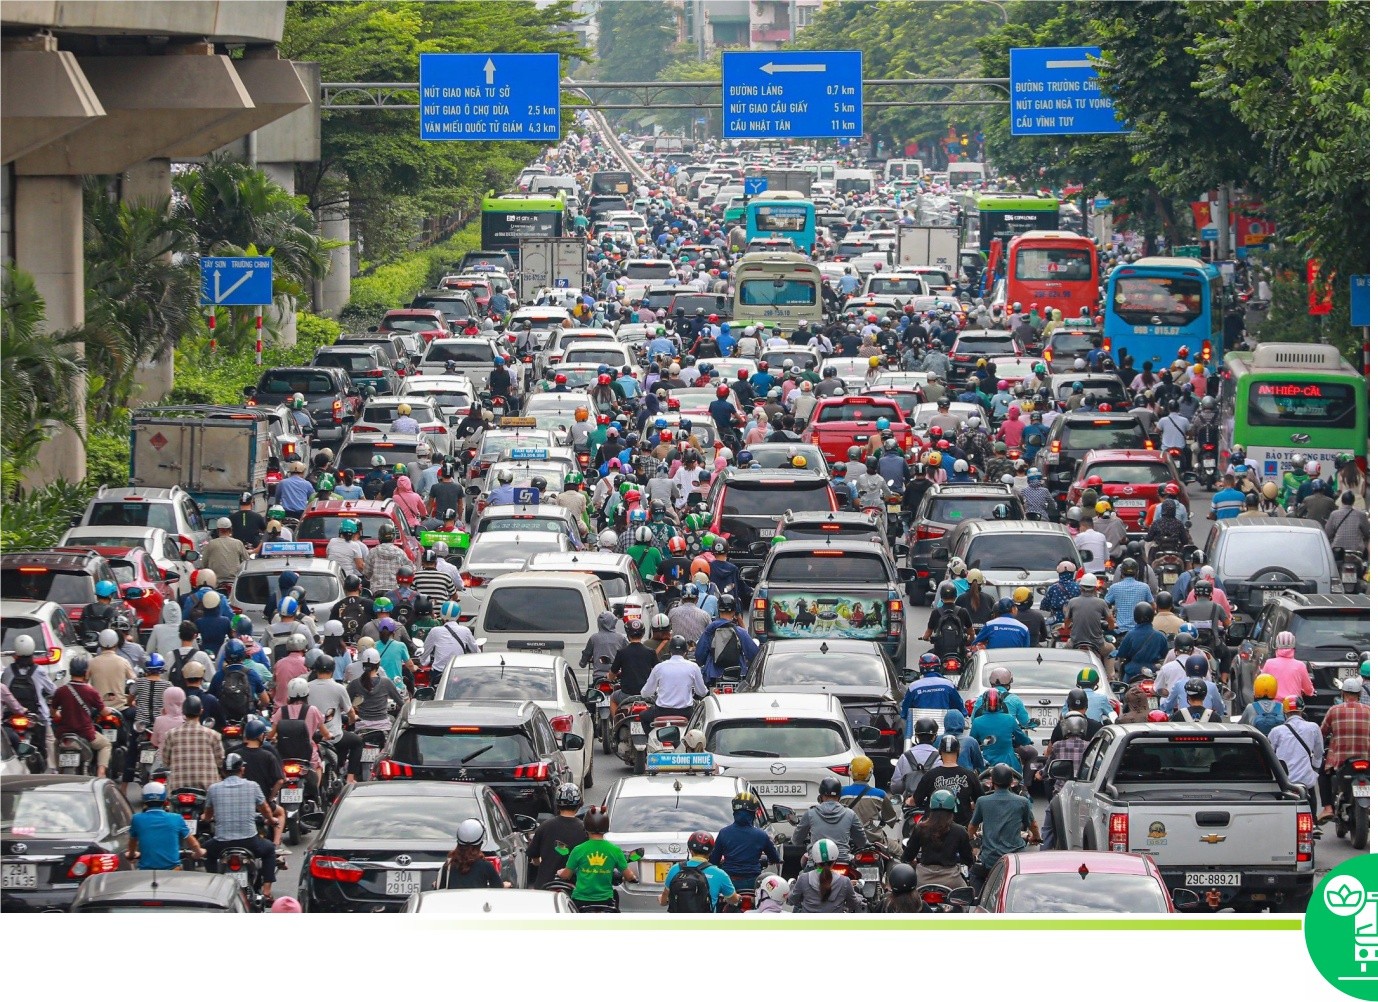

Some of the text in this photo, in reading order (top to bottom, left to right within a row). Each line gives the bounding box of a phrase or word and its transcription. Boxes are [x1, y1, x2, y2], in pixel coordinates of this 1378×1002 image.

[730, 83, 758, 96] ĐƯỜNG
[762, 83, 783, 96] LÁNG
[842, 85, 855, 95] km
[1016, 80, 1044, 92] ĐƯỜNG
[1048, 78, 1080, 92] TRƯỜNG
[424, 85, 511, 98] NÚT GIAO NGÃ TƯ SỞ
[730, 100, 855, 113] NÚT GIAO CẦU GIẤY 5 km
[1016, 97, 1112, 110] NÚT GIAO NGÃ TƯ VỌNG
[424, 103, 510, 117] NÚT GIAO Ô CHỢ DỪA
[544, 106, 556, 115] km
[424, 120, 522, 132] VĂN MIẾU QUỐC TỬ GIÁM
[730, 118, 855, 132] CẦU NHẬT TÂN 11 km
[1017, 115, 1074, 127] CẦU VĨNH TUY
[544, 123, 556, 132] km
[672, 755, 690, 764] SÔNG
[693, 755, 711, 766] NHUỆ
[10, 864, 27, 875] 29A
[395, 872, 412, 882] 30A
[1187, 874, 1239, 884] 29C-889.21
[387, 884, 419, 894] 291.95
